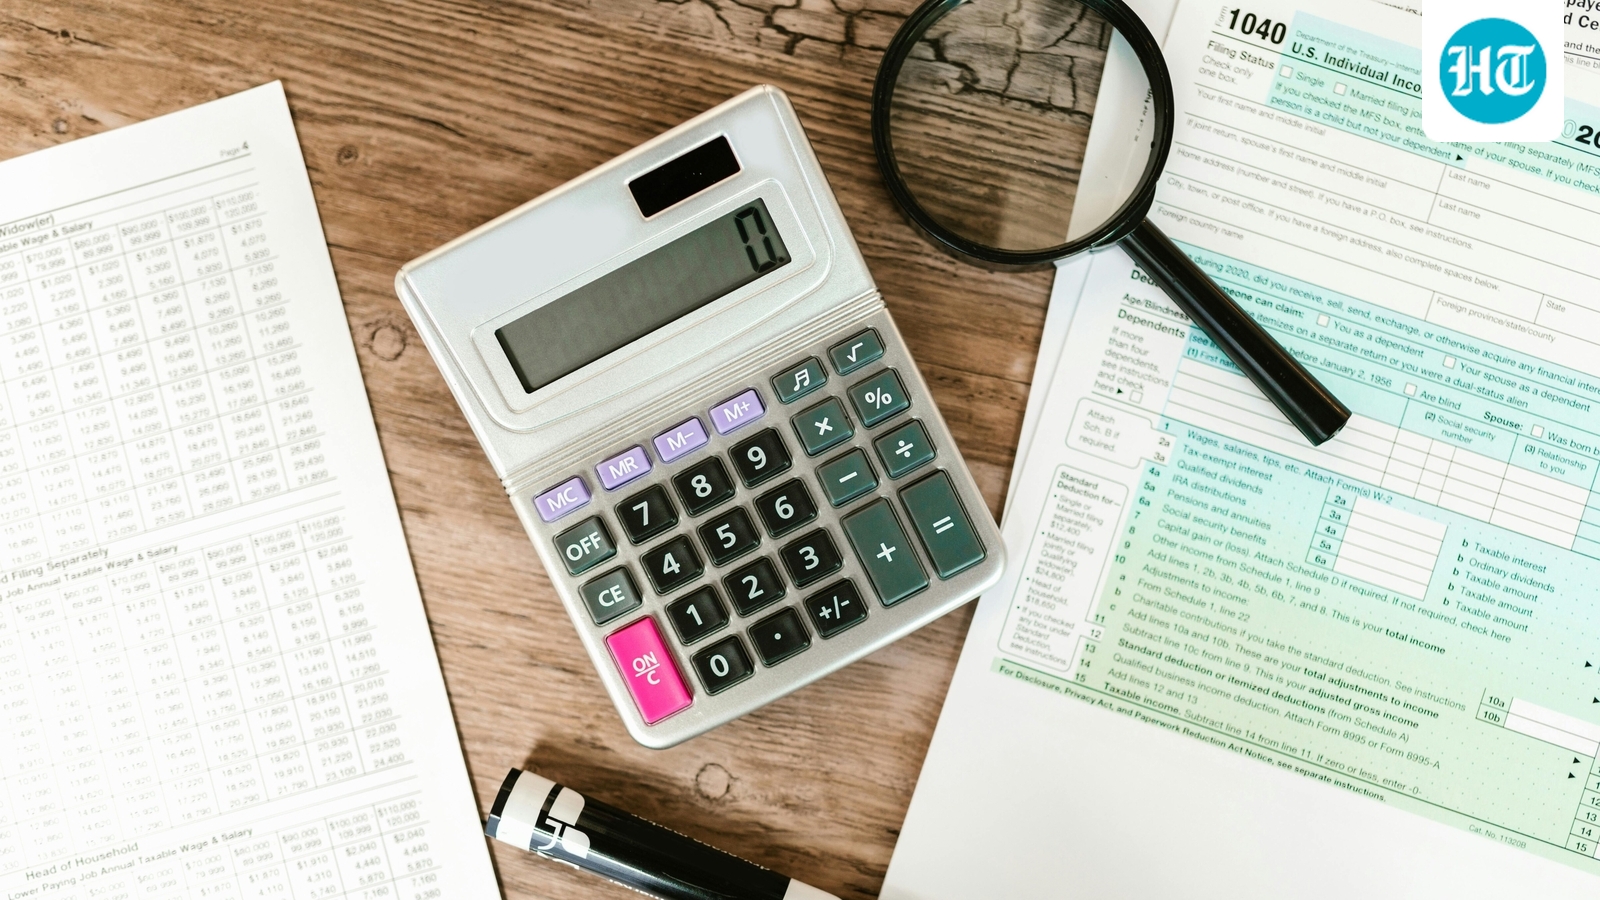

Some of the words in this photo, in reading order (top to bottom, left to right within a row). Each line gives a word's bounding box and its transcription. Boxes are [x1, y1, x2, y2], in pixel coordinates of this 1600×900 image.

[1229, 8, 1286, 44] 1040
[1578, 15, 1600, 31] Ce
[1207, 39, 1236, 59] Filing
[1239, 50, 1274, 69] Status
[1291, 41, 1317, 60] U.S.
[1323, 52, 1389, 82] Individual
[1392, 74, 1422, 93] Inco
[1295, 71, 1324, 87] Single
[1349, 88, 1386, 107] Married
[1386, 100, 1409, 116] filing
[1527, 148, 1574, 169] separately
[1448, 170, 1466, 182] Last
[1467, 177, 1490, 190] name
[1438, 199, 1456, 211] Last
[1457, 207, 1481, 219] name
[20, 233, 49, 246] Wage
[52, 229, 59, 238] &
[61, 221, 92, 235] Salary
[1545, 300, 1566, 312] State
[1117, 308, 1185, 338] Dependents
[1436, 296, 1467, 313] Foreign
[1467, 309, 1555, 343] province/state/county
[1289, 348, 1318, 363] before
[1319, 358, 1356, 377] January
[1357, 369, 1365, 380] 2,
[1370, 373, 1392, 387] 1956
[864, 387, 892, 409] %
[1419, 390, 1436, 402] Are
[1437, 395, 1461, 410] blind
[723, 401, 750, 422] M+
[1483, 411, 1523, 430] Spouse:
[1424, 411, 1436, 422] (2)
[1437, 415, 1463, 429] Social
[1463, 425, 1495, 441] security
[1441, 429, 1472, 444] number
[1158, 437, 1170, 447] 2a
[608, 456, 638, 479] MR
[747, 446, 766, 470] 9
[1153, 451, 1165, 462] 3a
[1183, 444, 1237, 469] Tax-exempt
[1238, 465, 1272, 481] interest
[1187, 429, 1218, 447] Wages,
[1223, 443, 1259, 461] salaries,
[1262, 455, 1281, 468] tips,
[1284, 464, 1299, 473] etc.
[1303, 468, 1334, 485] Attach
[1335, 478, 1370, 498] Form(s)
[1373, 490, 1392, 504] W-2
[1524, 443, 1535, 455] (3)
[1537, 447, 1587, 470] Relationship
[1539, 460, 1548, 469] to
[1549, 465, 1565, 475] you
[1060, 471, 1098, 490] Standard
[1148, 467, 1160, 476] 4a
[1177, 459, 1218, 479] Qualified
[1218, 474, 1263, 495] dividends
[691, 474, 712, 497] 8
[1172, 474, 1188, 486] IRA
[1190, 481, 1246, 506] distributions
[546, 486, 578, 511] MC
[775, 495, 794, 519] 6
[1334, 495, 1346, 505] 2a
[632, 500, 649, 526] 7
[932, 515, 954, 534] =
[716, 523, 736, 548] 5
[1324, 525, 1336, 535] 4a
[566, 531, 601, 560] OFF
[876, 542, 896, 562] +
[1461, 538, 1468, 547] b
[11, 566, 43, 580] Filing
[46, 547, 108, 570] Separately
[663, 552, 680, 574] 4
[798, 546, 819, 570] 3
[1457, 553, 1463, 562] b
[1475, 542, 1510, 561] Taxable
[1511, 557, 1546, 573] interest
[6, 587, 23, 598] Job
[27, 576, 61, 592] Annual
[64, 566, 103, 580] Taxable
[105, 557, 134, 569] Wage
[137, 553, 144, 561] &
[146, 545, 178, 557] Salary
[1468, 557, 1508, 578] Ordinary
[1510, 572, 1554, 593] dividends
[598, 584, 625, 606] CE
[741, 575, 764, 599] 2
[686, 604, 703, 625] 1
[1090, 629, 1101, 638] 12
[1385, 628, 1408, 641] total
[1409, 637, 1445, 654] income
[632, 651, 660, 675] ON
[710, 654, 729, 676] 0
[647, 669, 660, 685] C
[1075, 672, 1085, 682] 15
[1118, 638, 1163, 659] Standard
[1164, 654, 1212, 676] deduction
[1214, 672, 1225, 680] or
[1227, 675, 1270, 695] itemized
[1271, 690, 1325, 714] deductions
[1104, 681, 1141, 701] Taxable
[1143, 697, 1179, 714] income.
[1489, 696, 1505, 707] 10a
[1484, 711, 1500, 722] 10b
[999, 665, 1013, 675] For
[1015, 670, 1061, 693] Disclosure,
[1064, 687, 1096, 704] Privacy
[1097, 698, 1113, 710] Act,
[1116, 706, 1133, 716] and
[1134, 710, 1180, 732] Paperwork
[1182, 727, 1226, 747] Reduction
[1227, 742, 1243, 753] Act
[1244, 748, 1274, 765] Notice,
[1277, 760, 1292, 769] see
[1294, 766, 1332, 783] separate
[1333, 779, 1383, 801] instructions.
[1585, 811, 1598, 823] 13
[1468, 824, 1481, 834] Cat.
[1484, 829, 1495, 838] No.
[1500, 834, 1526, 849] 11320B
[1580, 826, 1592, 837] 14
[1575, 841, 1588, 852] 15
[7, 887, 38, 900] Lower
[41, 877, 76, 891] Paying
[79, 870, 97, 881] Job
[100, 859, 135, 875] Annual
[138, 849, 177, 864] Taxable
[179, 840, 208, 852] Wage
[211, 836, 219, 844] &
[221, 828, 252, 841] Salary
[25, 864, 57, 880] Head
[60, 860, 71, 871] of
[74, 842, 138, 867] Household
